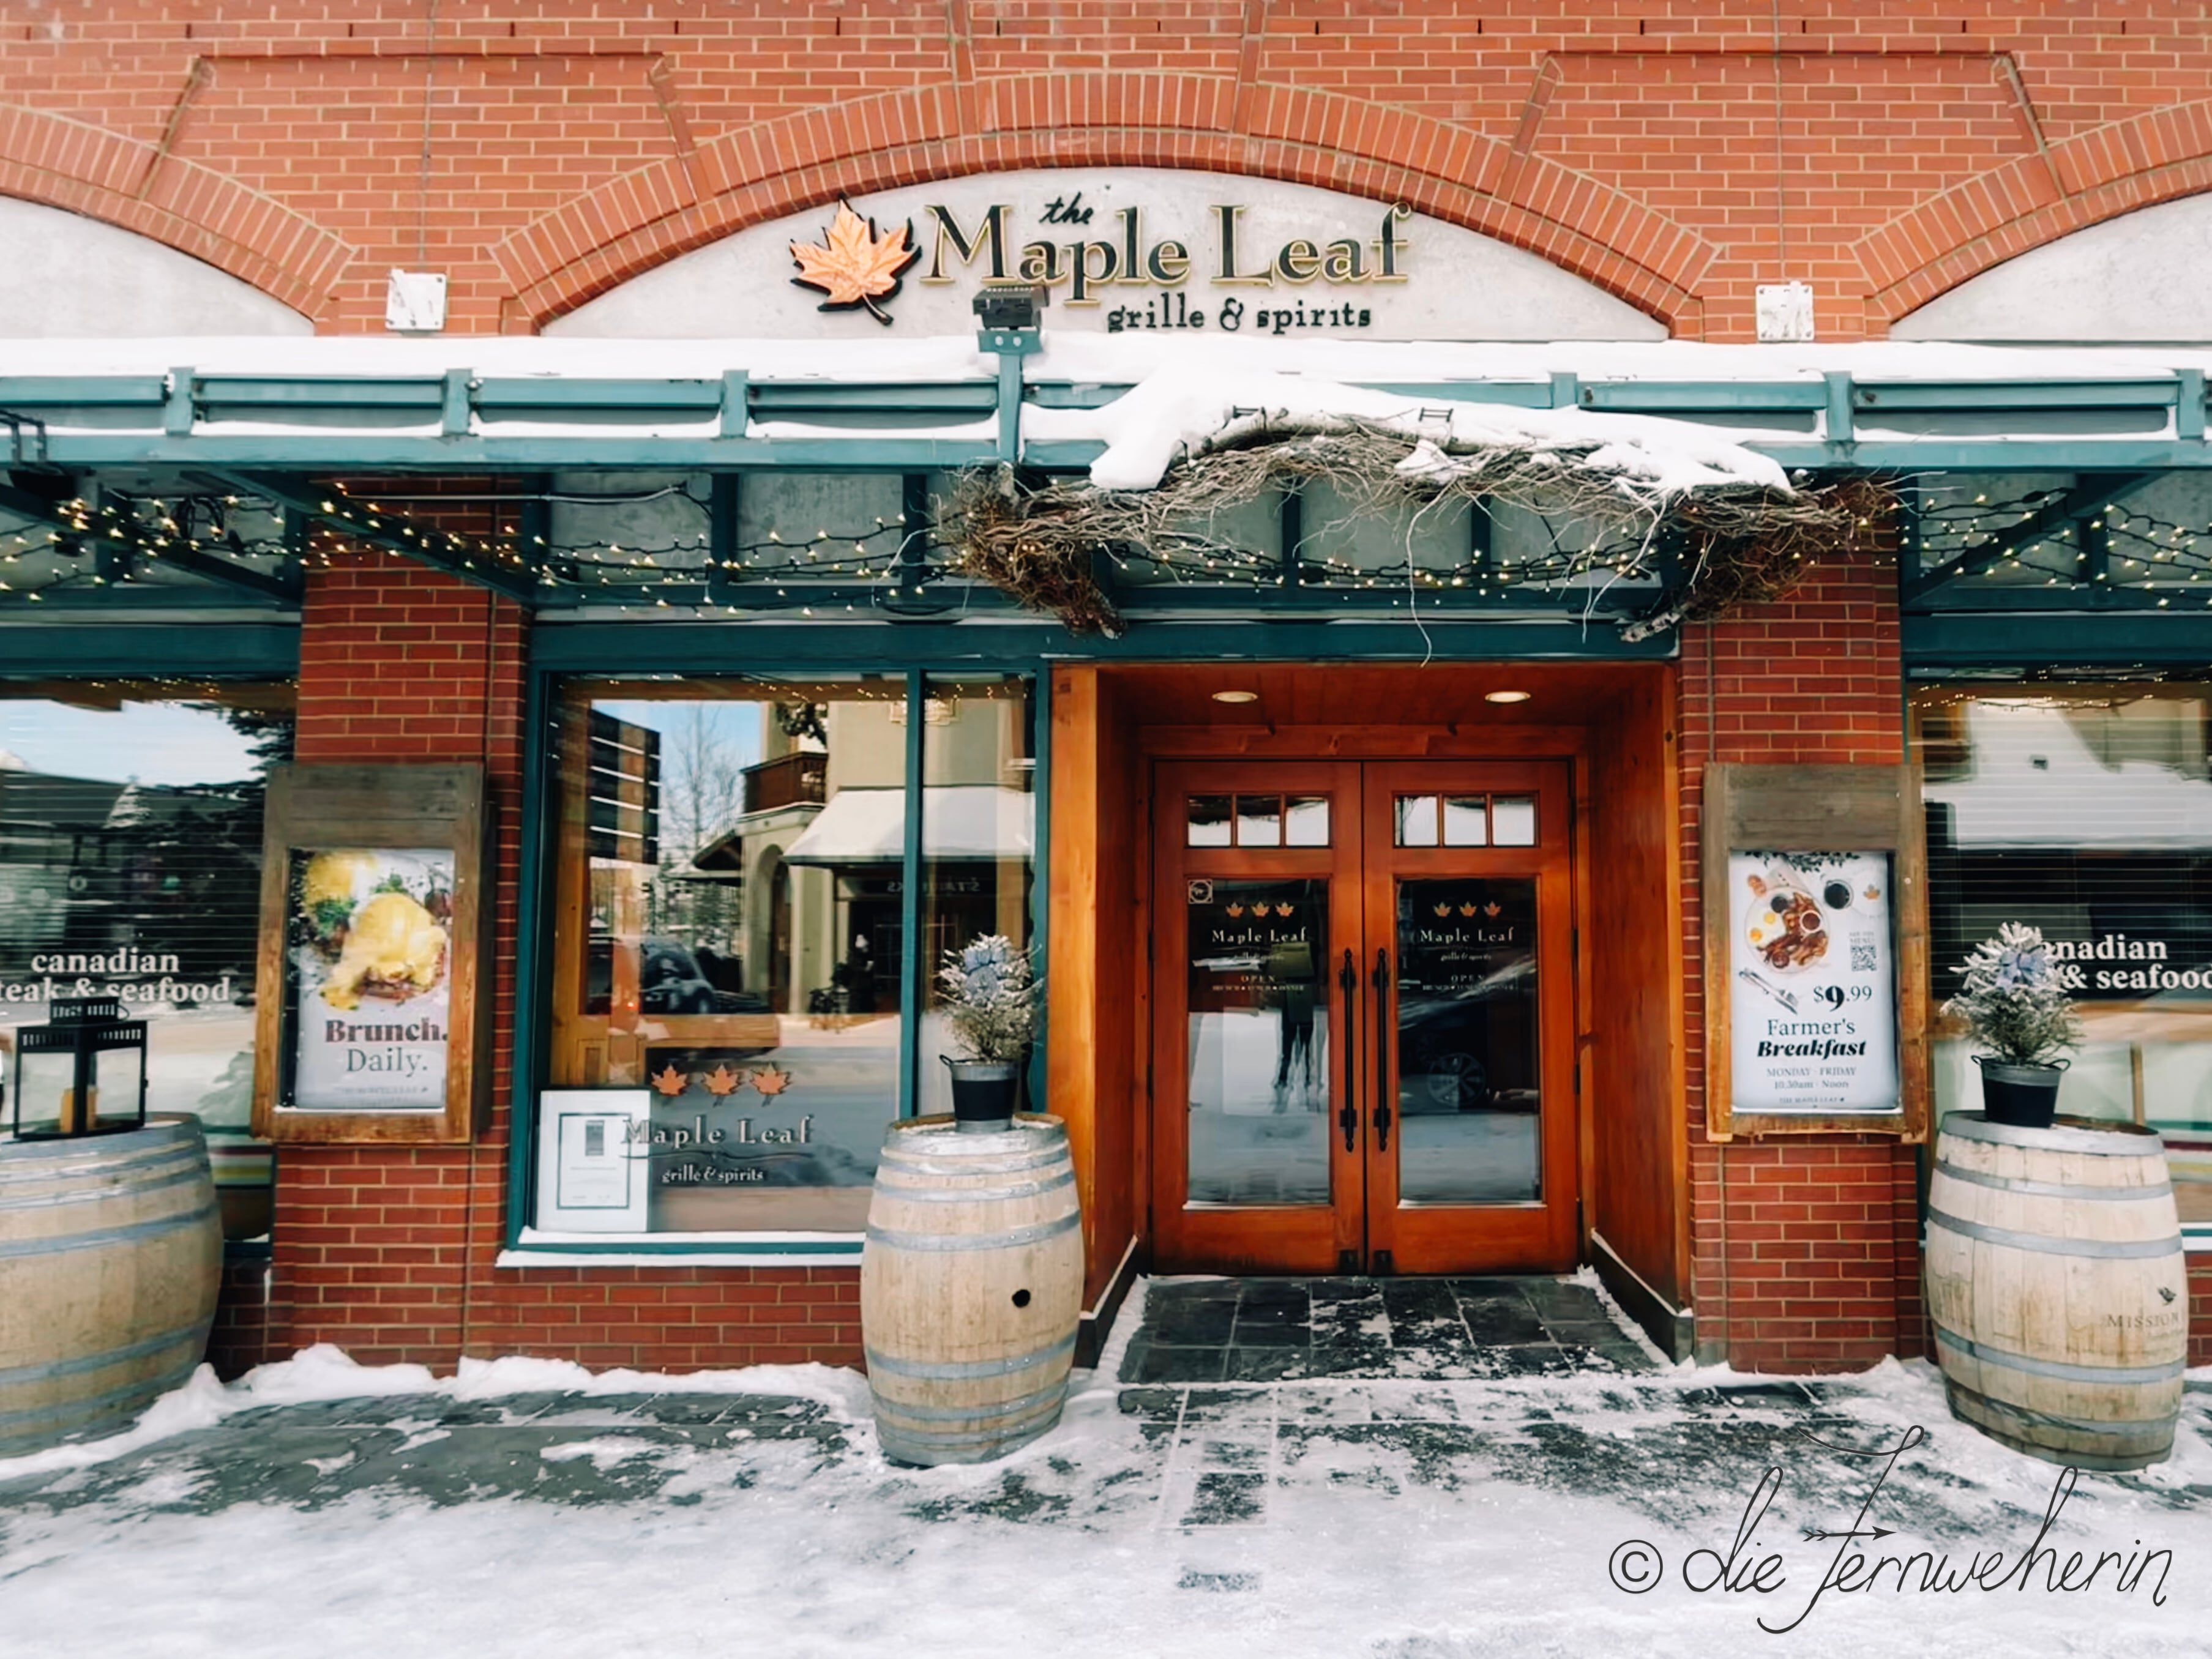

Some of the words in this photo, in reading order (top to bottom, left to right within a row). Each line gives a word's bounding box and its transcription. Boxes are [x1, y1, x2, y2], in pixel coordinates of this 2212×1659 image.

[1038, 192, 1093, 226] the
[920, 204, 1192, 307] Maple
[1209, 201, 1411, 286] Leaf
[1106, 293, 1204, 334] grille
[1218, 297, 1243, 332] &
[1255, 300, 1372, 335] spirits
[1212, 928, 1262, 944] Maple
[1271, 926, 1307, 942] Leaf
[1421, 928, 1470, 944] Maple
[1478, 926, 1514, 942] Leaf
[31, 947, 179, 973] canadian
[71, 977, 96, 997] &
[106, 976, 230, 1002] seafood
[2062, 964, 2088, 990] &
[1814, 985, 1872, 1012] $9.99
[325, 1018, 447, 1043] Brunch.
[1768, 1019, 1855, 1036] Farmer's
[347, 1047, 428, 1077] Daily.
[1757, 1039, 1867, 1060] Breakfast
[1766, 1067, 1810, 1077] MONDAY
[1820, 1067, 1856, 1076] FRIDAY
[621, 1114, 726, 1149] Maple
[739, 1113, 815, 1145] Leaf
[662, 1164, 700, 1184] grille
[717, 1165, 763, 1184] spirits
